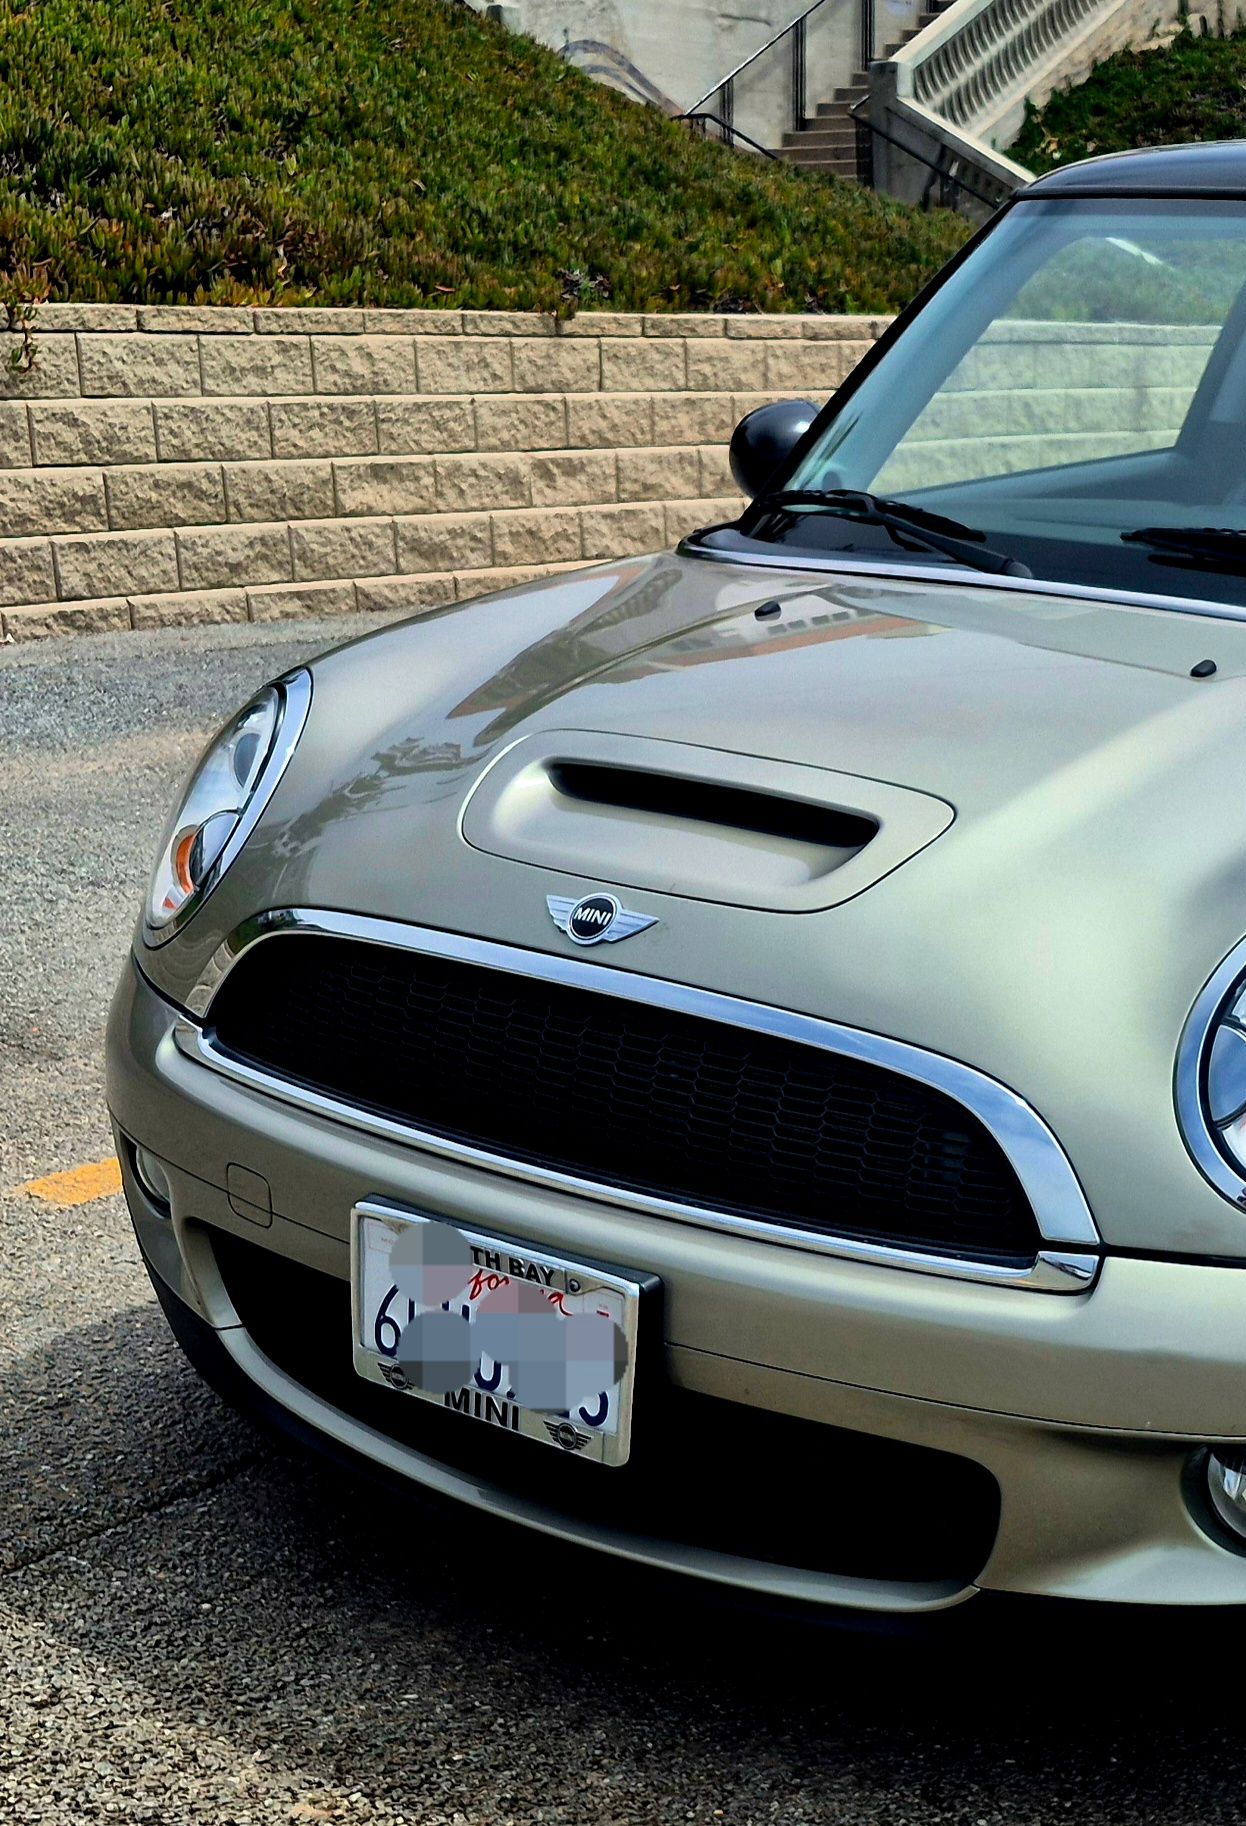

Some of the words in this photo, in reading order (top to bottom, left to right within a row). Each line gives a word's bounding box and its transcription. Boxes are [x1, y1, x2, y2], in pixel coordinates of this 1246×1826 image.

[573, 907, 612, 926] MINI
[503, 1254, 556, 1287] BAY
[444, 1386, 520, 1431] MINI
